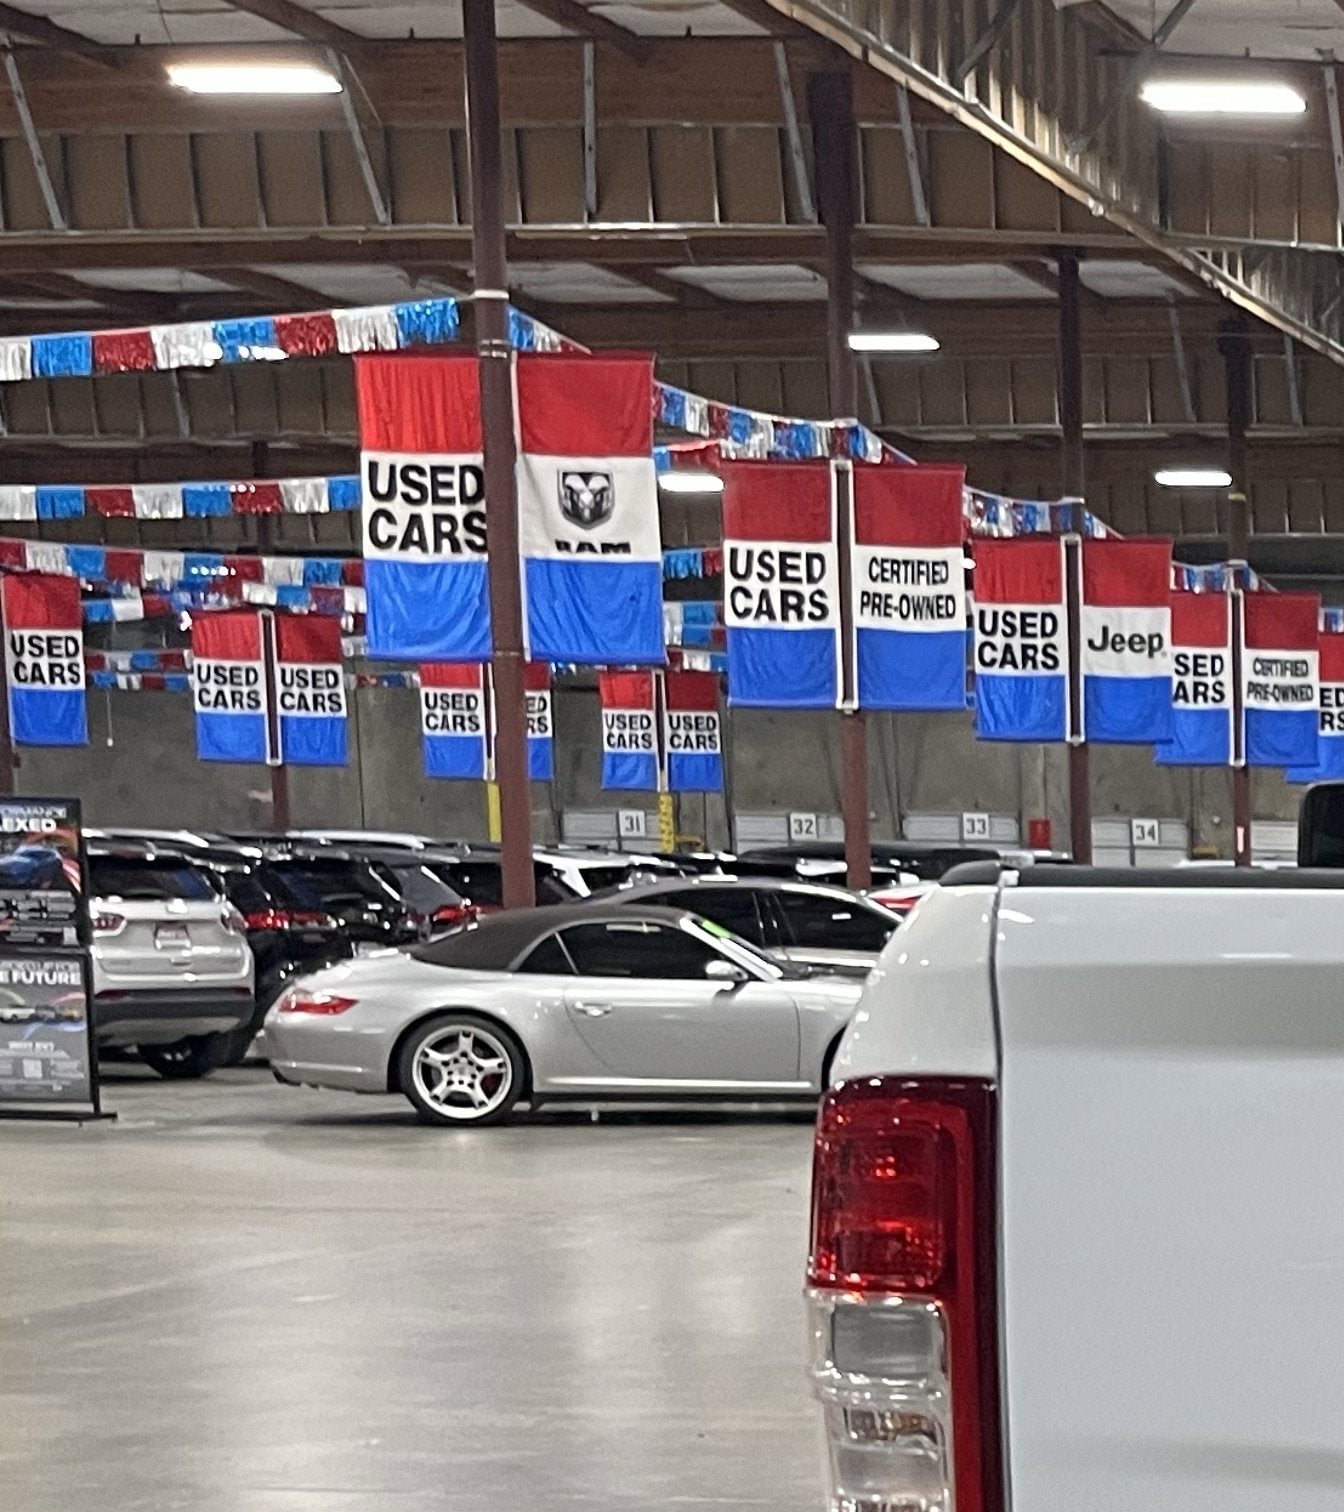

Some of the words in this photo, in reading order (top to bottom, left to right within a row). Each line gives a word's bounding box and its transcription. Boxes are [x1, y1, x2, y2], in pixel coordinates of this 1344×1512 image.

[368, 460, 485, 506] USED
[368, 508, 488, 554] CARS
[729, 547, 827, 585] USED
[868, 556, 950, 586] CERTIFIED
[730, 586, 830, 623] CARS
[860, 591, 956, 620] PRE-OWNED
[977, 609, 1059, 639] USED
[10, 635, 80, 658] USED
[1087, 625, 1164, 659] Jeep
[977, 641, 1060, 671] CARS
[1174, 652, 1225, 678] SED
[1252, 656, 1309, 678] CERTIFIED
[13, 661, 82, 685] CARS
[196, 663, 259, 687] USED
[280, 666, 339, 689] USED
[197, 688, 262, 710] CARS
[280, 691, 343, 713] CARS
[424, 692, 479, 711] USED
[526, 693, 547, 713] ED
[1173, 680, 1226, 704] ARS
[1246, 681, 1314, 703] PRE-OWNED
[425, 713, 481, 732] CARS
[527, 715, 549, 735] RS
[604, 713, 652, 730] USED
[668, 714, 717, 731] USED
[605, 733, 653, 749] CARS
[669, 733, 718, 750] CARS
[624, 815, 641, 832] 31
[793, 818, 814, 835] 32
[965, 817, 987, 835] 33
[1135, 824, 1156, 841] 34
